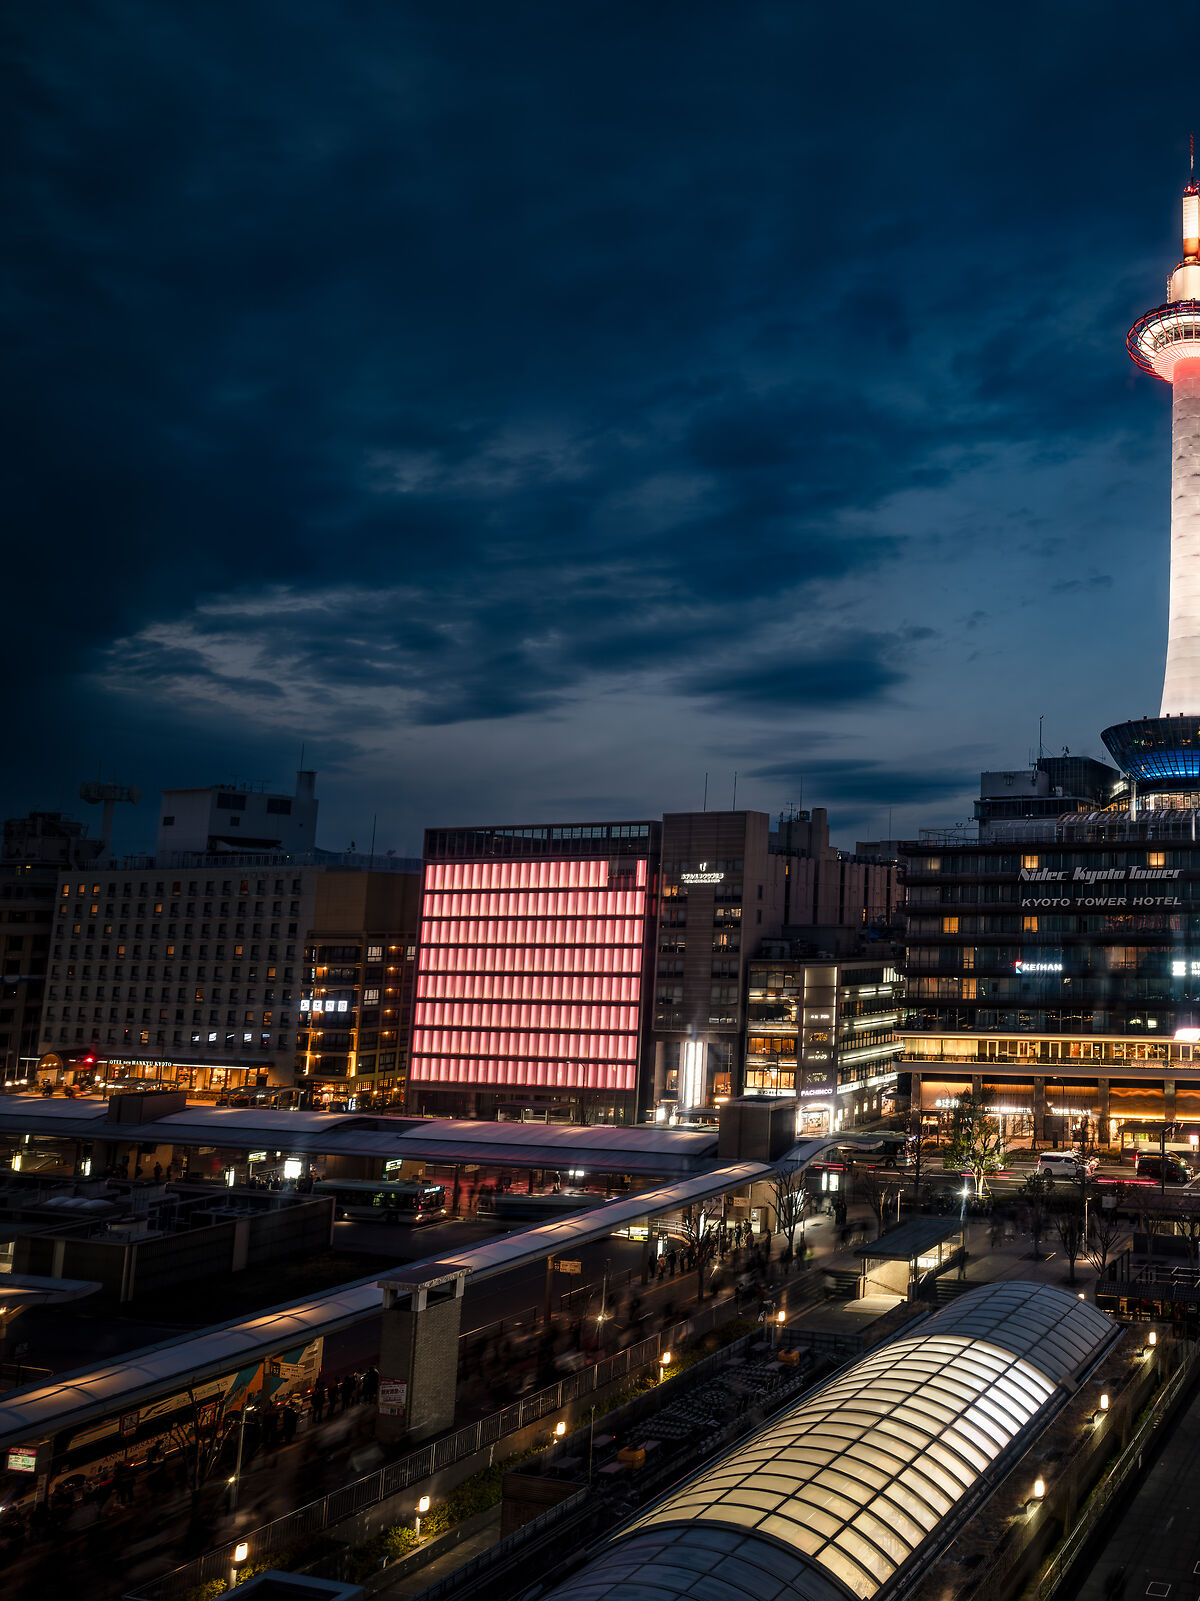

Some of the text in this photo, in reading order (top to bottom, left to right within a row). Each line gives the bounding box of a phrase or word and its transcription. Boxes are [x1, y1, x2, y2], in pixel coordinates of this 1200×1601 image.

[1018, 866, 1184, 885] Nidec Kyoto Tower
[1021, 897, 1182, 907] KYOTO TOWER HOTEL
[1022, 963, 1063, 971] KEIHAN
